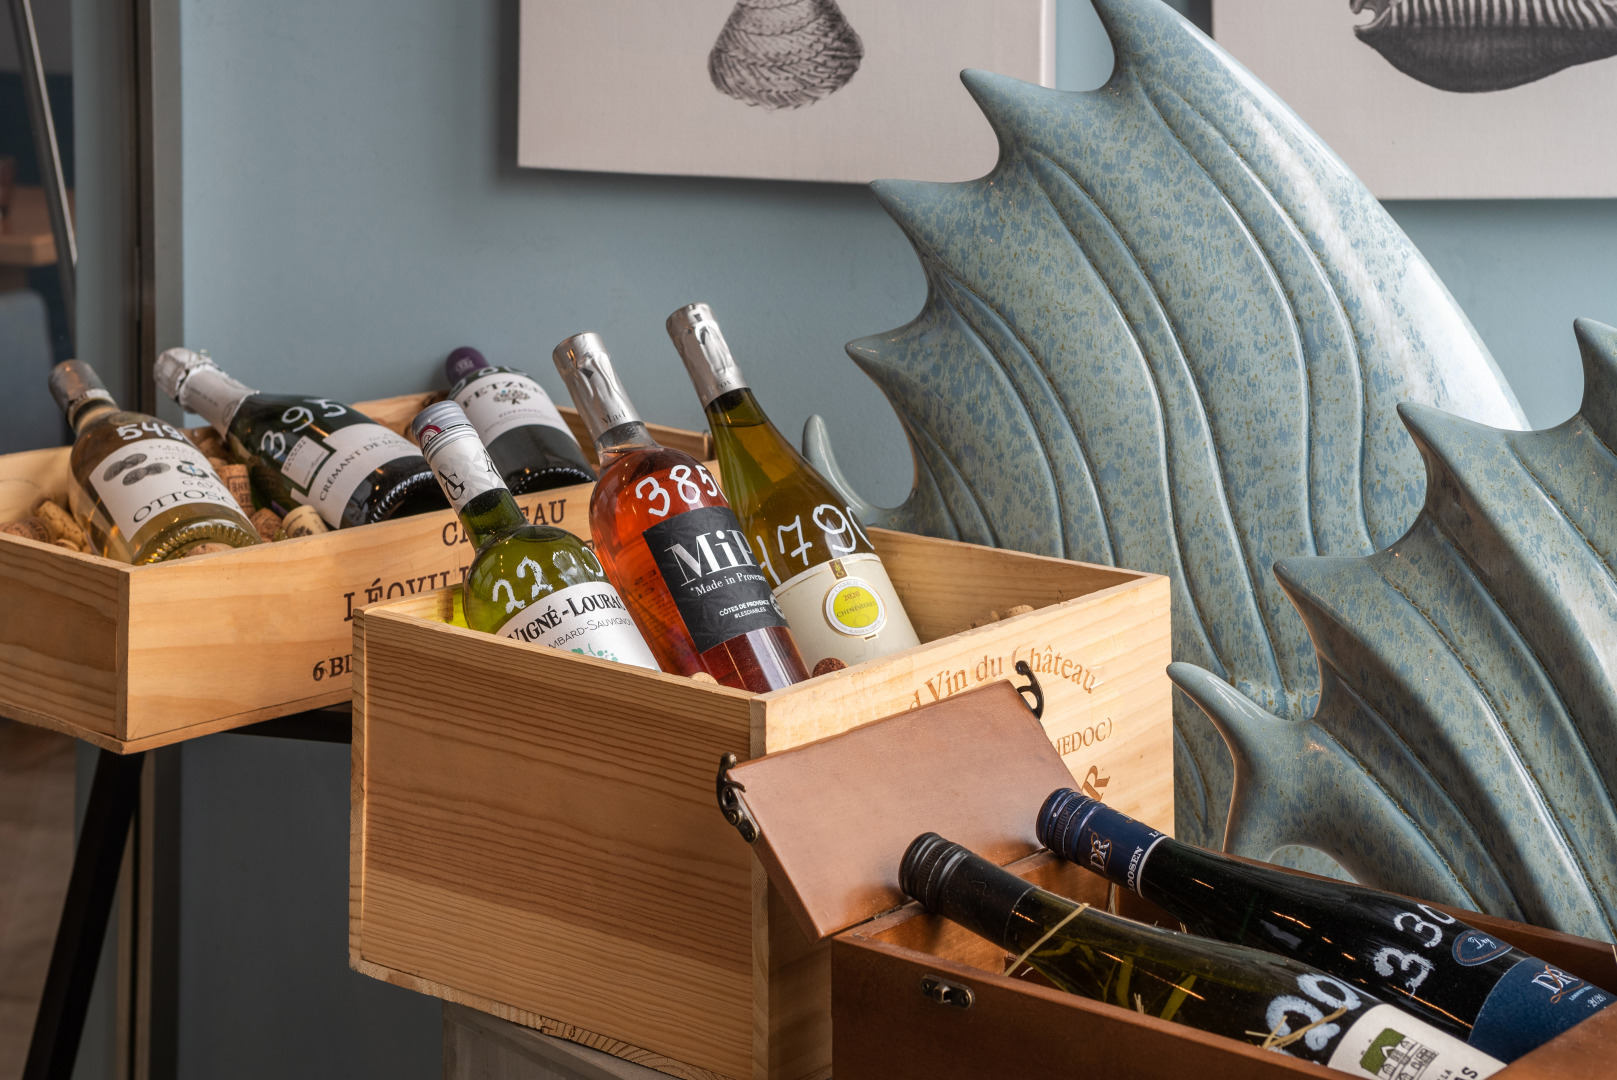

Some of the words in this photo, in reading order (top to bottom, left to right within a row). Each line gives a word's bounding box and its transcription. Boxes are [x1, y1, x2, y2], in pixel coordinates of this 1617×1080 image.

[261, 398, 347, 460] 395
[725, 575, 736, 585] in
[842, 590, 860, 602] 2020
[719, 605, 738, 617] CÔTES
[738, 602, 747, 612] DE
[924, 668, 969, 702] Vin
[975, 654, 1004, 682] du
[1467, 936, 1497, 950] Dry
